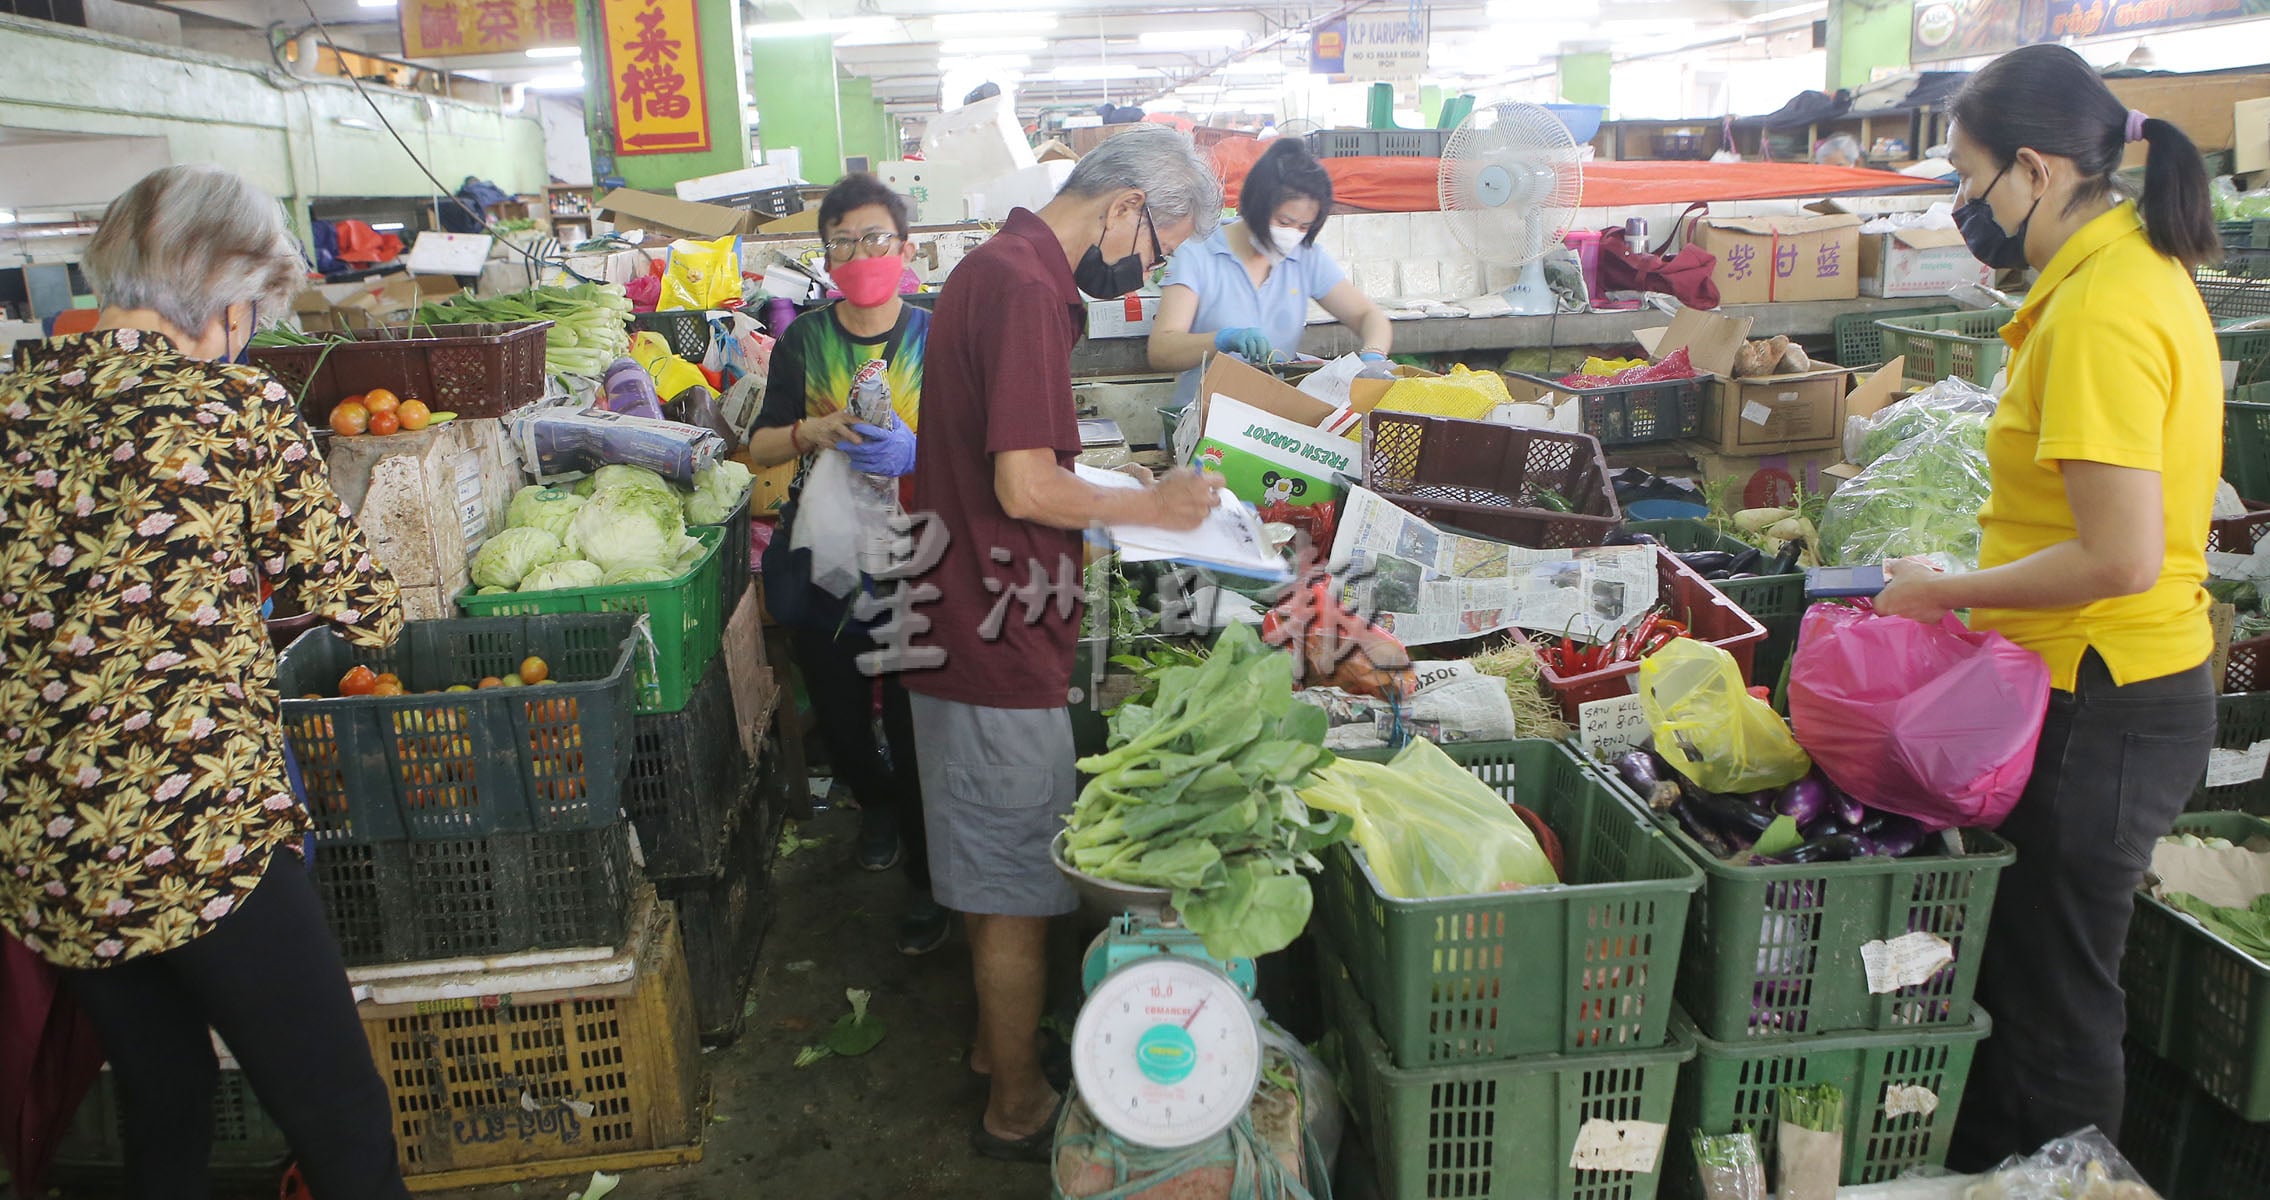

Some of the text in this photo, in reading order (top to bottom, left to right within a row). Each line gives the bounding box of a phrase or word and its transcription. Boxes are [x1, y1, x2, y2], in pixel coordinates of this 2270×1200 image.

[620, 0, 691, 122] 菜檔
[1242, 424, 1349, 471] FRESH CARROT
[1584, 706, 1610, 718] SATU
[1587, 720, 1607, 733] RM
